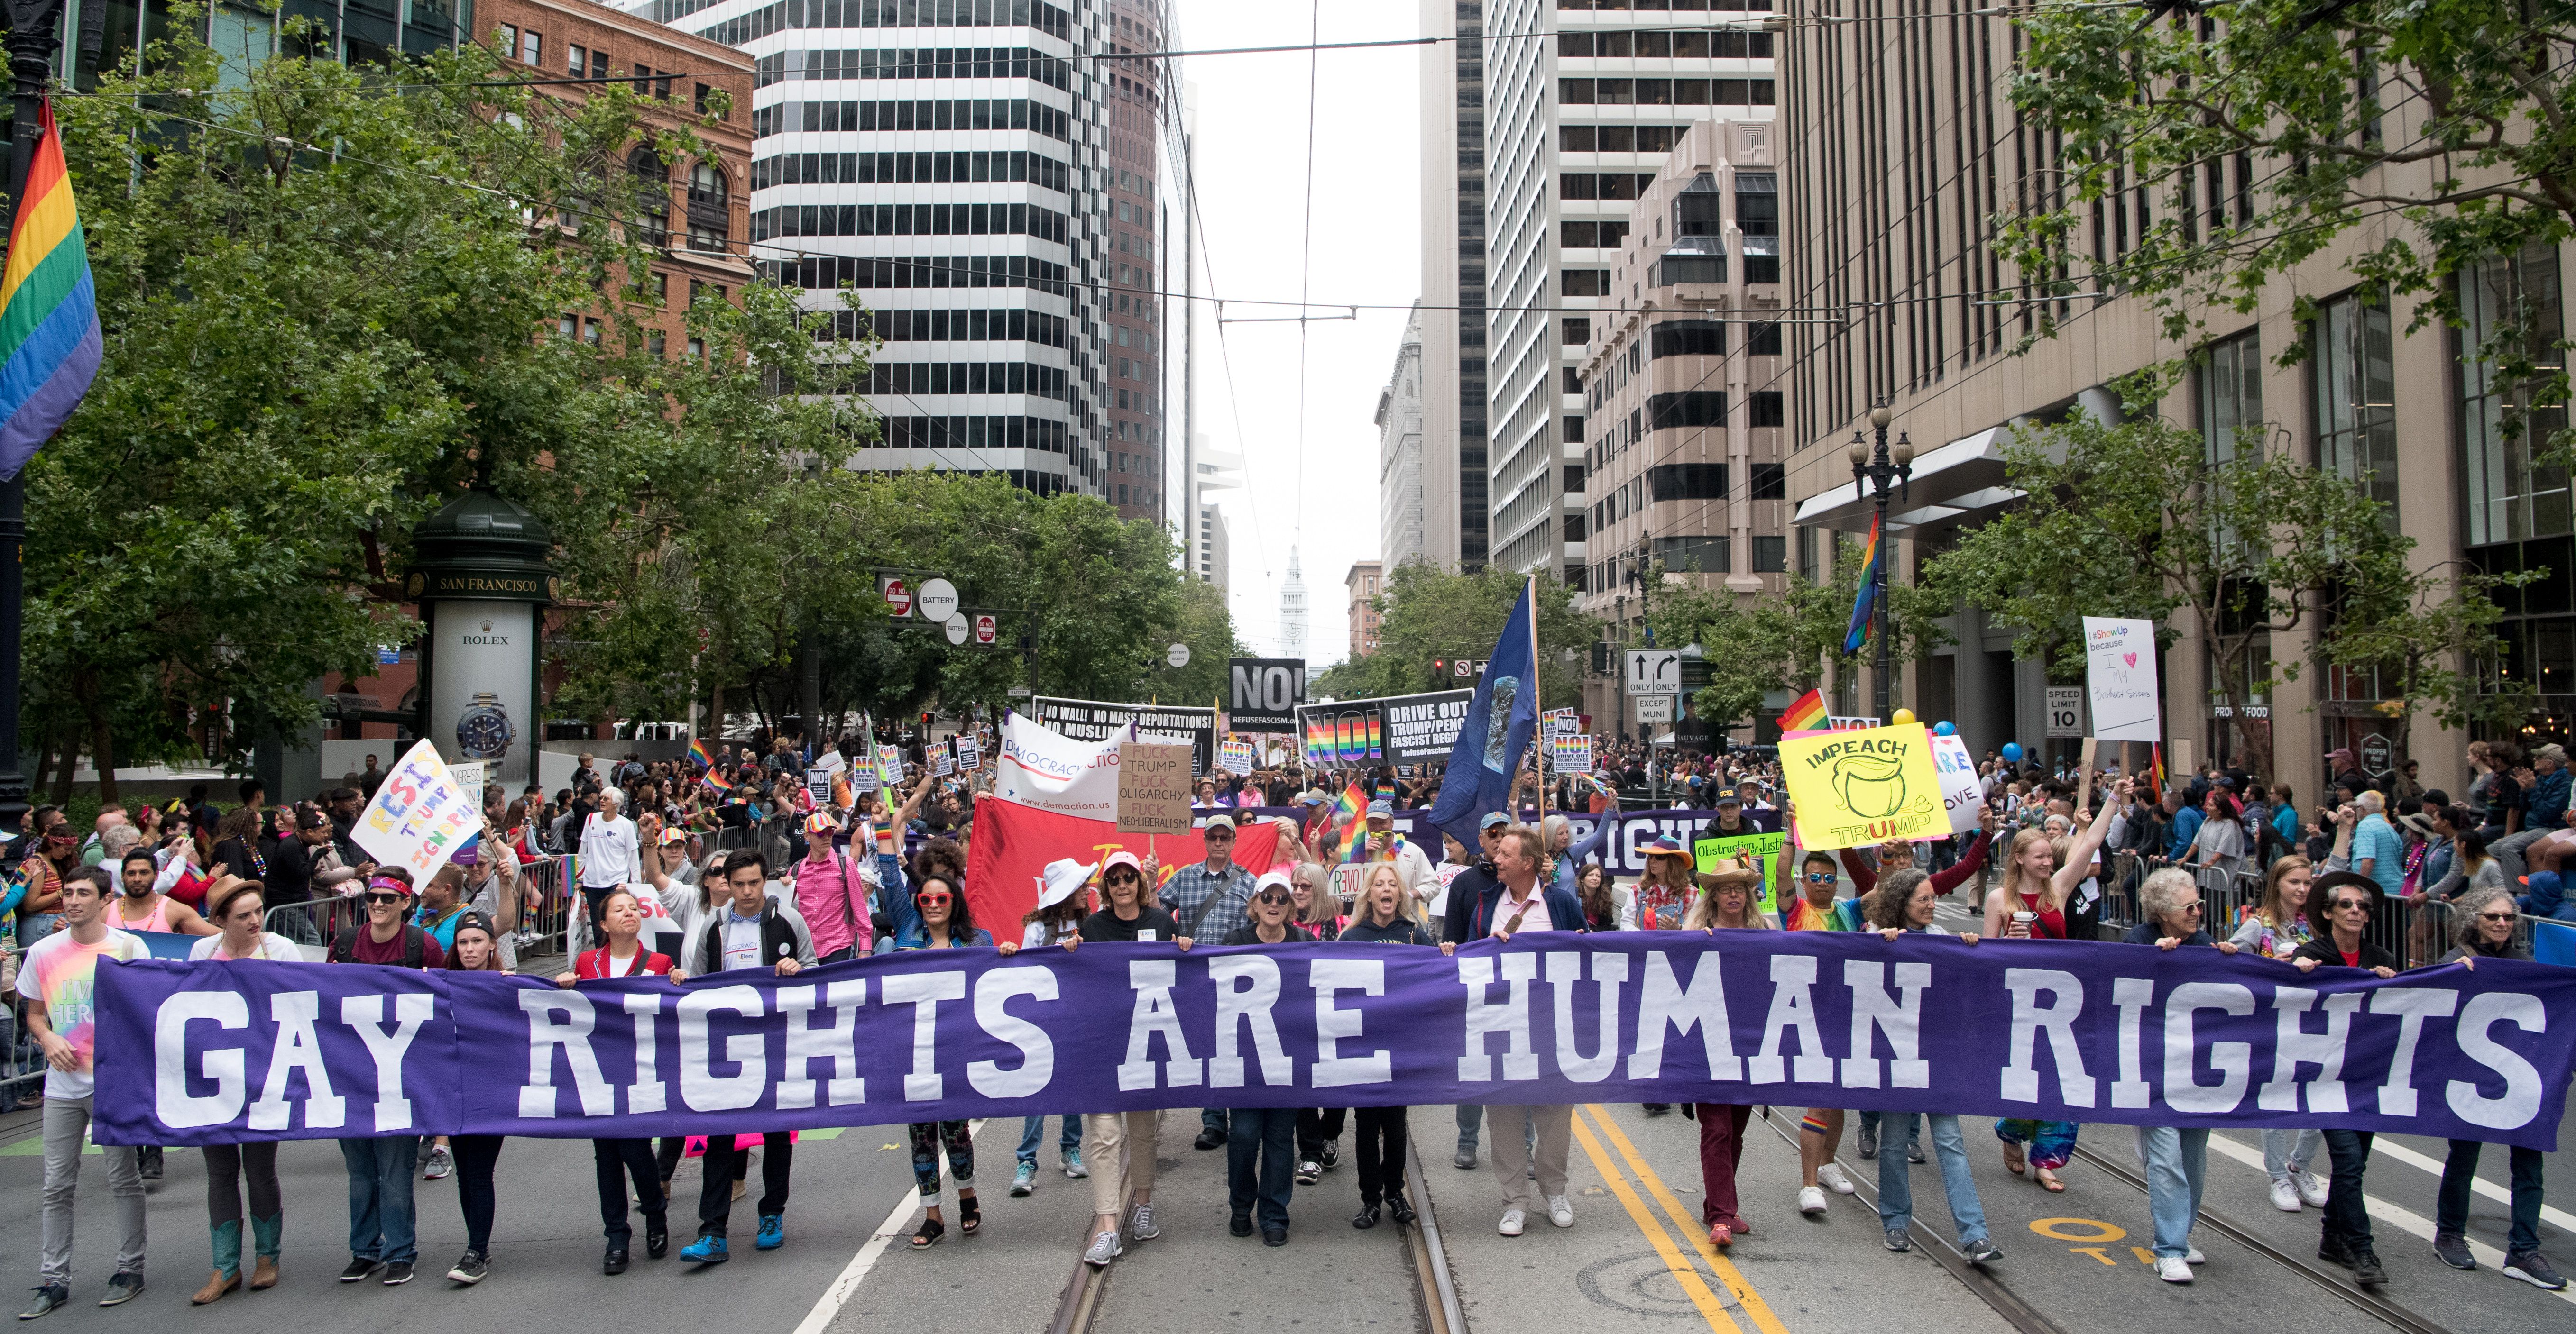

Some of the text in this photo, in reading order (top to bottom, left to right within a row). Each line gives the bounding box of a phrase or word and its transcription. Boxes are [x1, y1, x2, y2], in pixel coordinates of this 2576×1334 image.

[441, 578, 536, 592] SAN FRANCISCO
[463, 636, 508, 644] ROLEX
[2088, 626, 2128, 640] I #ShowUp
[2090, 640, 2123, 651] because
[2103, 654, 2116, 669] I
[1232, 666, 1304, 711] NO!
[1046, 705, 1058, 719] NO
[1060, 707, 1088, 722] WALL!
[1094, 710, 1107, 723] NO
[1139, 713, 1211, 729] DEPORTATIONS!
[1390, 701, 1469, 723] DRIVE OUT
[2053, 711, 2075, 726] 10
[2246, 707, 2268, 717] FOOD
[1044, 721, 1061, 734] NO
[1391, 718, 1465, 736] TRUMP/PENC
[1559, 719, 1576, 731] NO!
[1307, 709, 1381, 762] NO!
[1391, 734, 1430, 748] FASCIST
[1132, 746, 1170, 758] FUCK
[1224, 743, 1250, 758] NO!
[1555, 736, 1589, 754] NO!
[1006, 739, 1084, 775] DEMOCRACY
[1806, 739, 1907, 769] IMPEACH
[1128, 760, 1176, 772] TRUMP
[811, 772, 828, 784] NO!
[1132, 775, 1169, 787] FUCK
[1120, 788, 1185, 801] OLIGARCHY
[1021, 796, 1110, 810] www.demaction.us
[1131, 803, 1166, 816] FUCK
[1119, 816, 1187, 829] NEO-LIBERALISM
[1831, 813, 1931, 845] TRUMP
[1698, 837, 1785, 857] Obstruction of Justi
[62, 979, 93, 1000] I'M
[53, 1004, 93, 1024] HER
[155, 951, 2546, 1133] GAY RIGHTS ARE HUMAN RIGHTS
